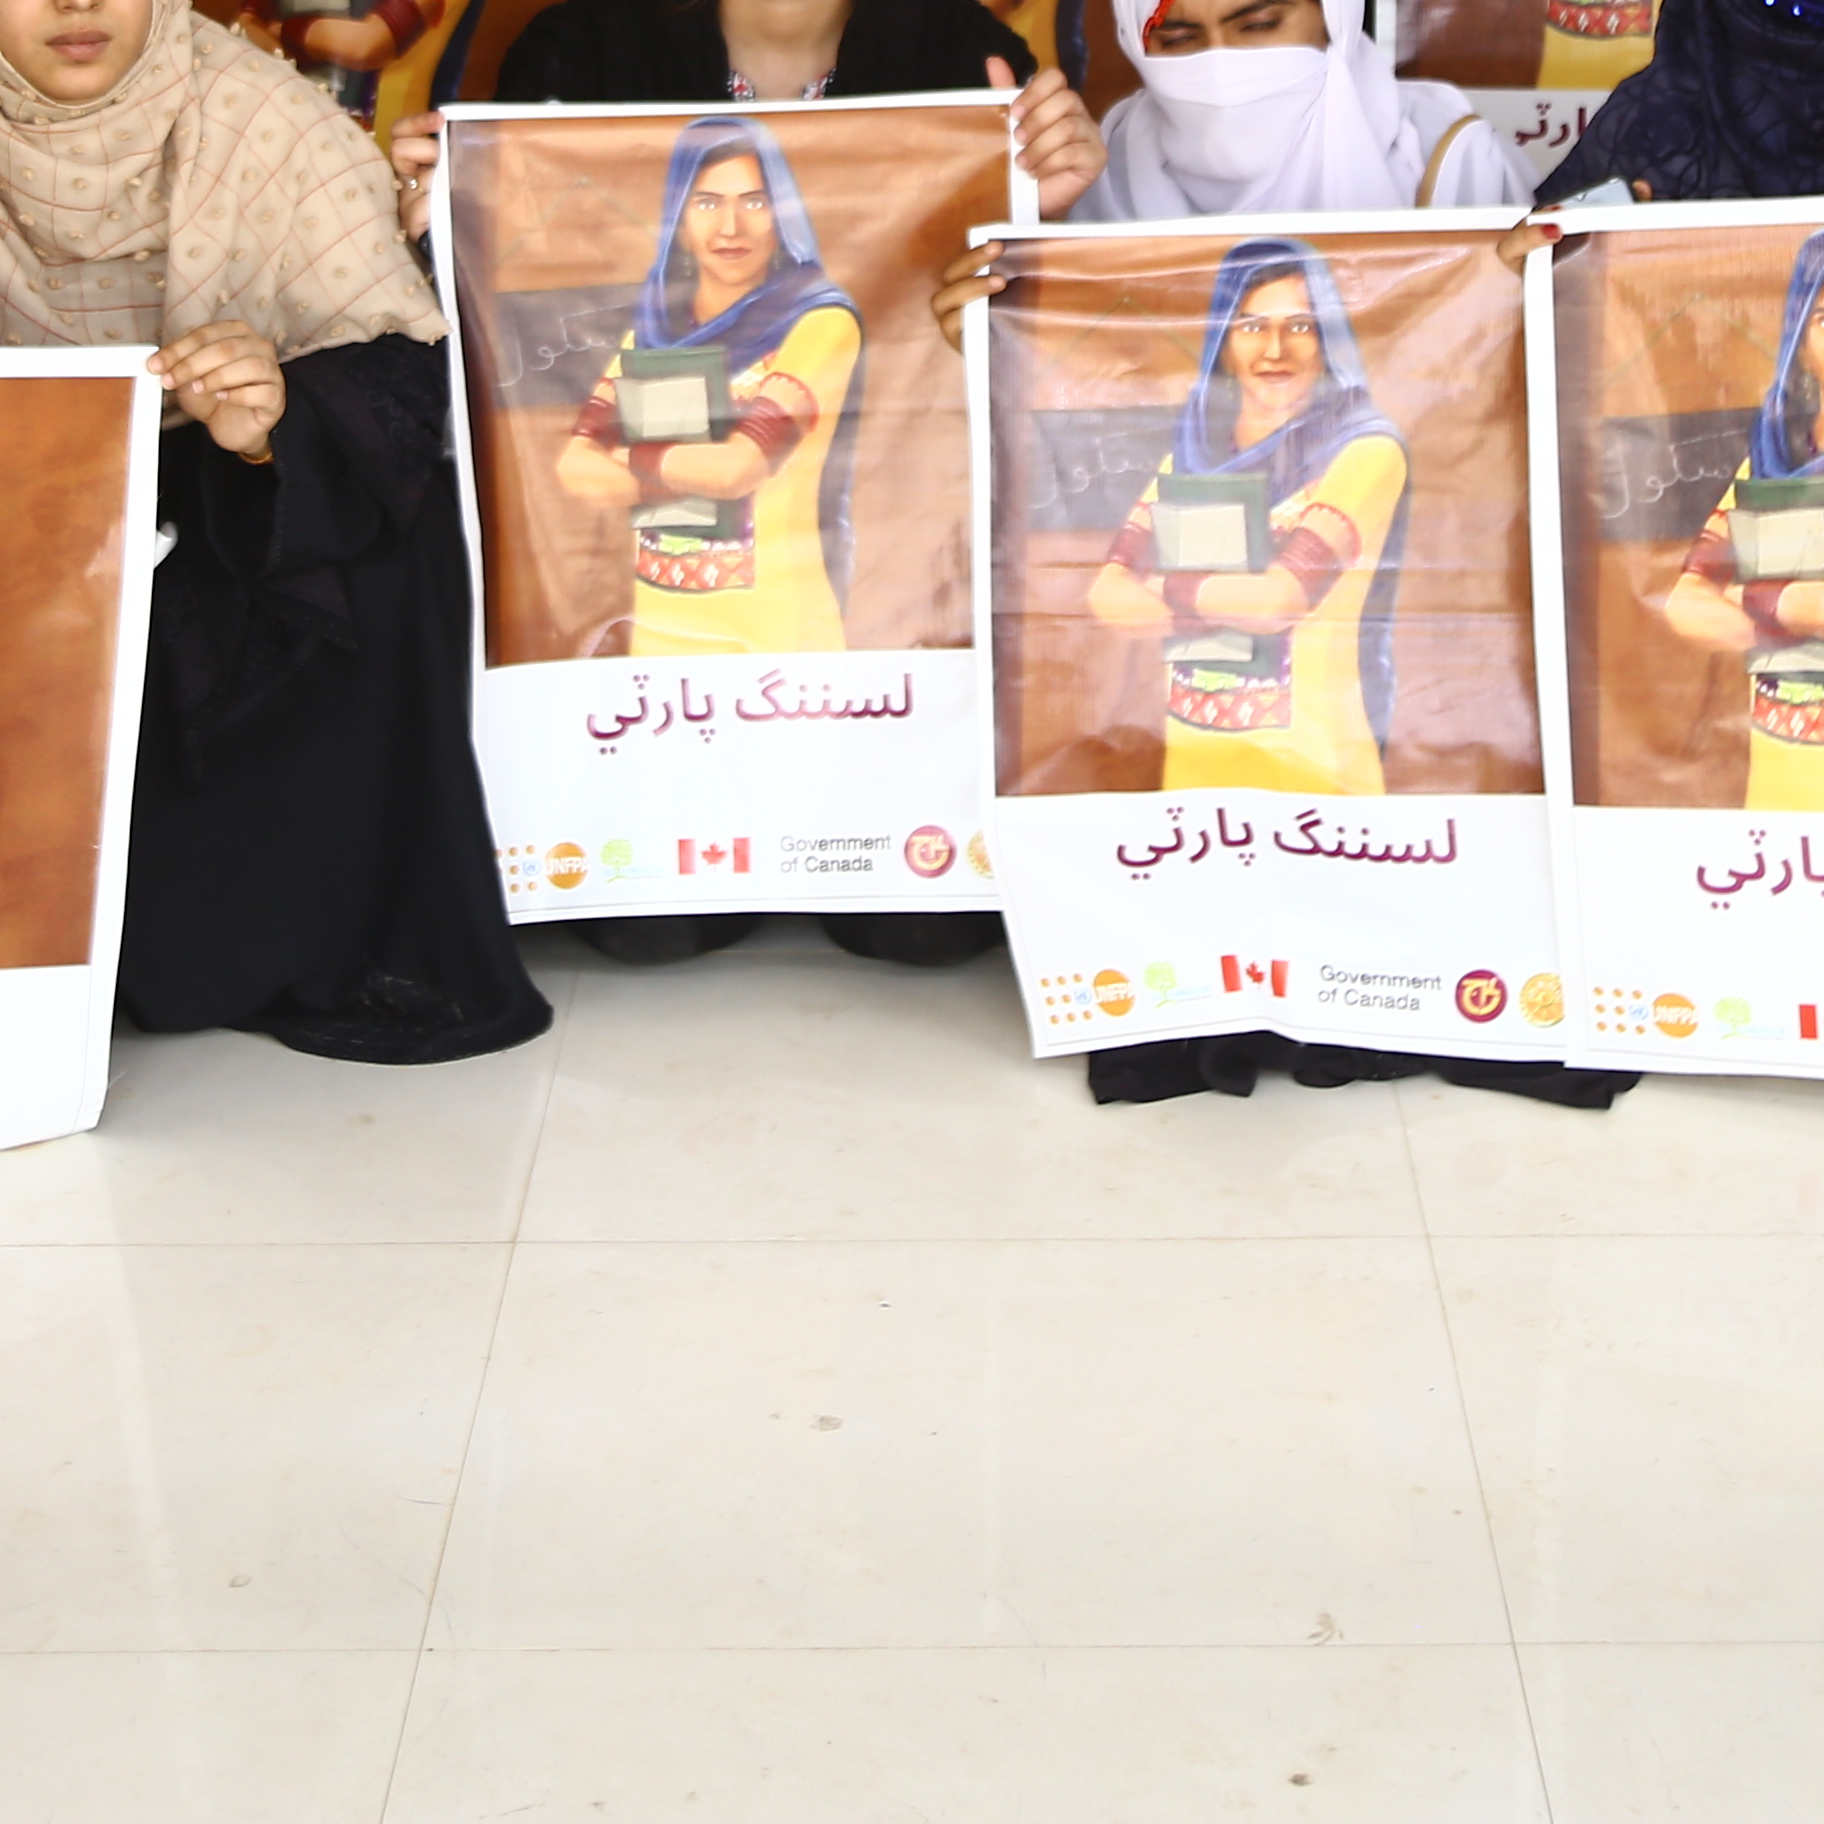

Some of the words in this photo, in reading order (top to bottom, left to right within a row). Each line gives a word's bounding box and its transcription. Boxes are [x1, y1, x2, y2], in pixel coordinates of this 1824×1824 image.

[781, 835, 891, 852] Government
[780, 857, 798, 873] of
[805, 856, 873, 873] Canada
[1320, 964, 1441, 990] Government
[1318, 988, 1338, 1004] of
[1344, 988, 1420, 1011] Canada
